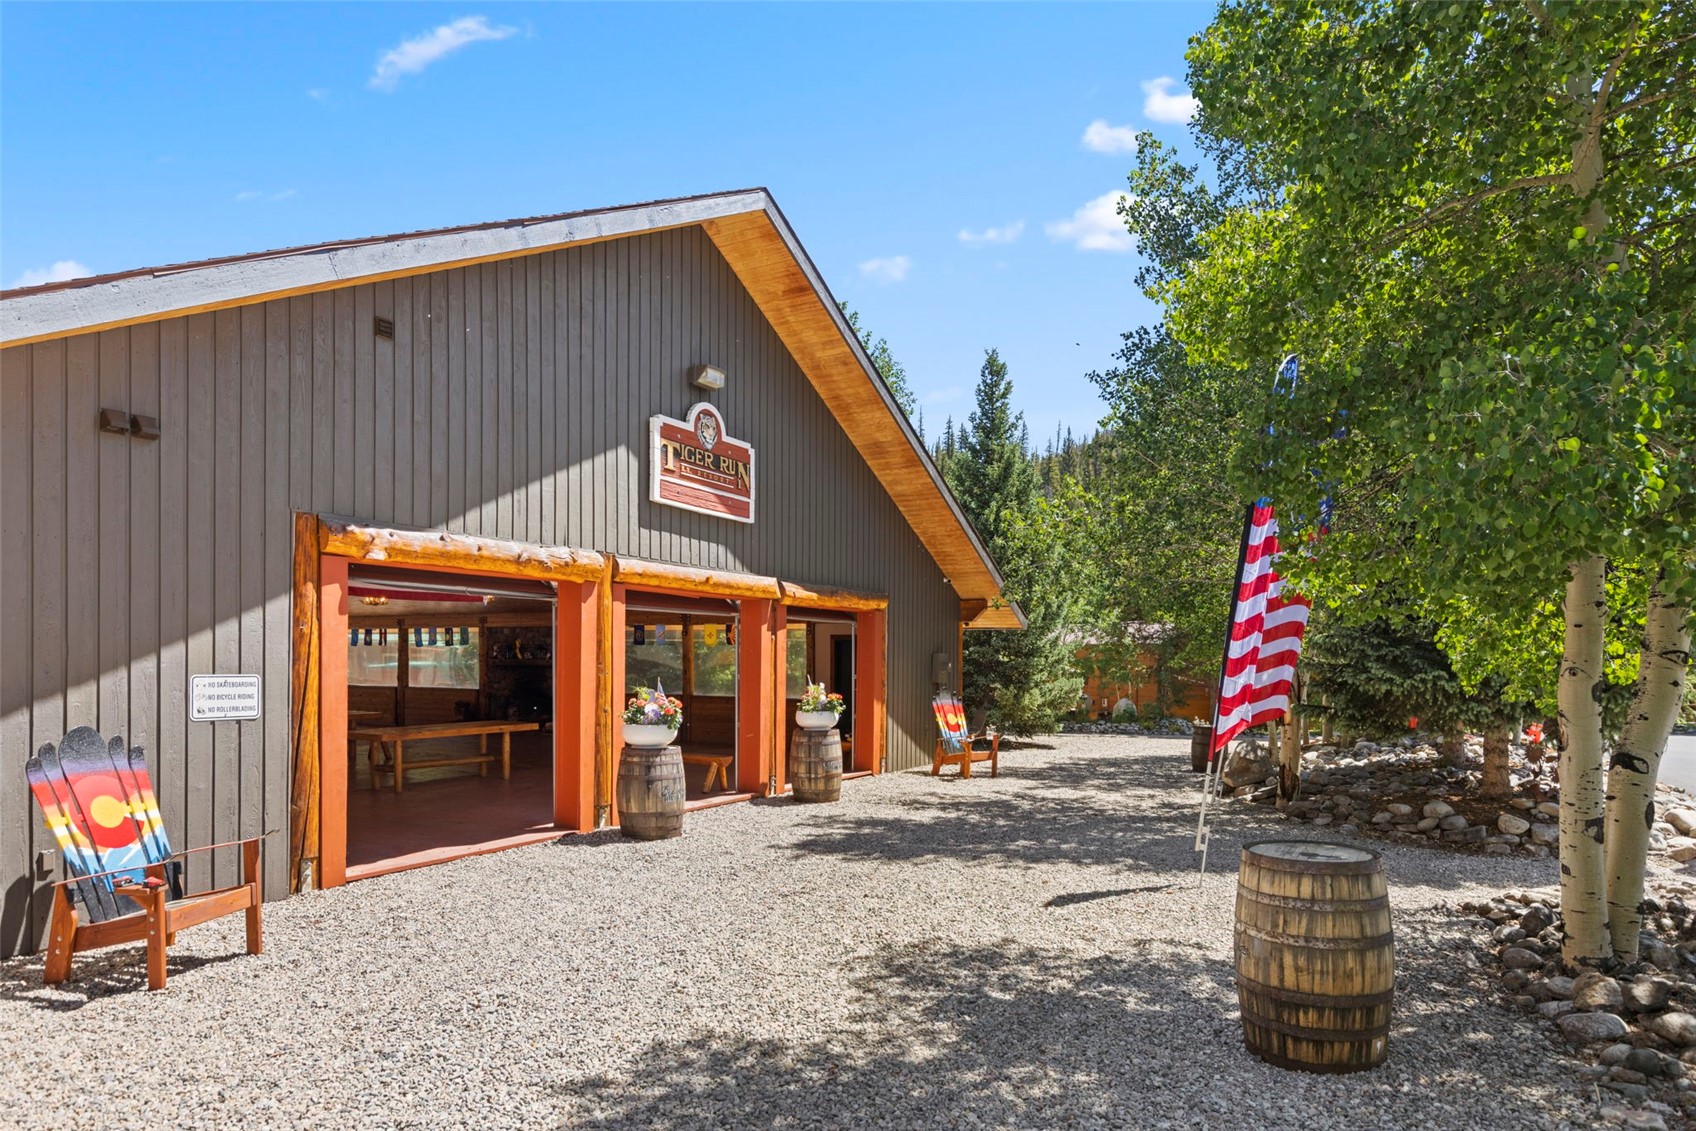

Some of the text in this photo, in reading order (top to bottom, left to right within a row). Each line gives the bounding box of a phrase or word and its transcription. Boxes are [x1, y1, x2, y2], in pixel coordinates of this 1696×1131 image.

[661, 438, 750, 490] TIGER RUN
[217, 705, 256, 713] ROLLERBLADING
